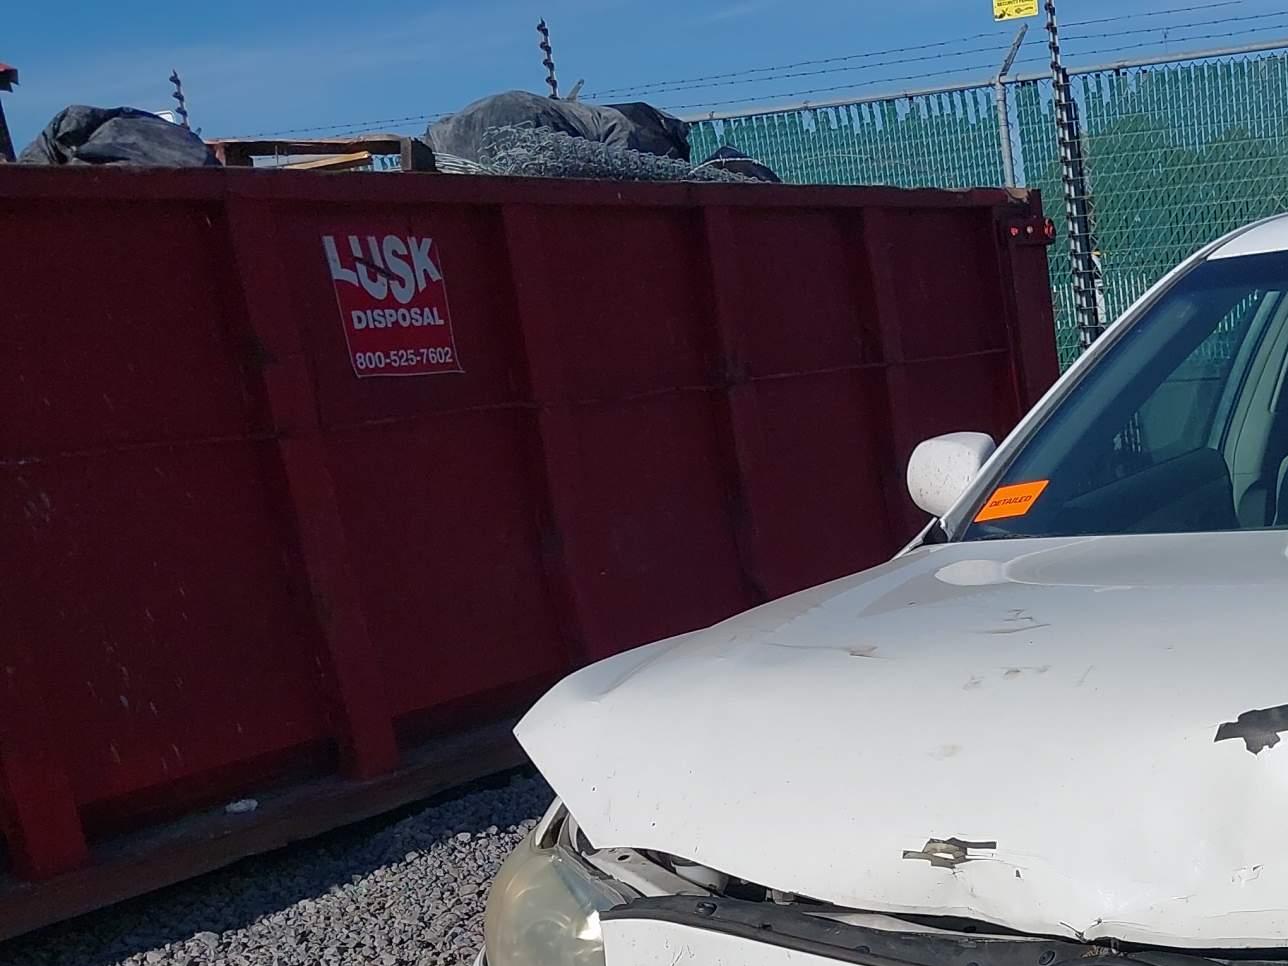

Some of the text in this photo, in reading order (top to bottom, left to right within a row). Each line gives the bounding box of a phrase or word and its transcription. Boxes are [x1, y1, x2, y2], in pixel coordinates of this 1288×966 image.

[322, 234, 443, 304] LUSK
[351, 306, 445, 330] DISPOSAL
[356, 347, 454, 369] 800-525-7602
